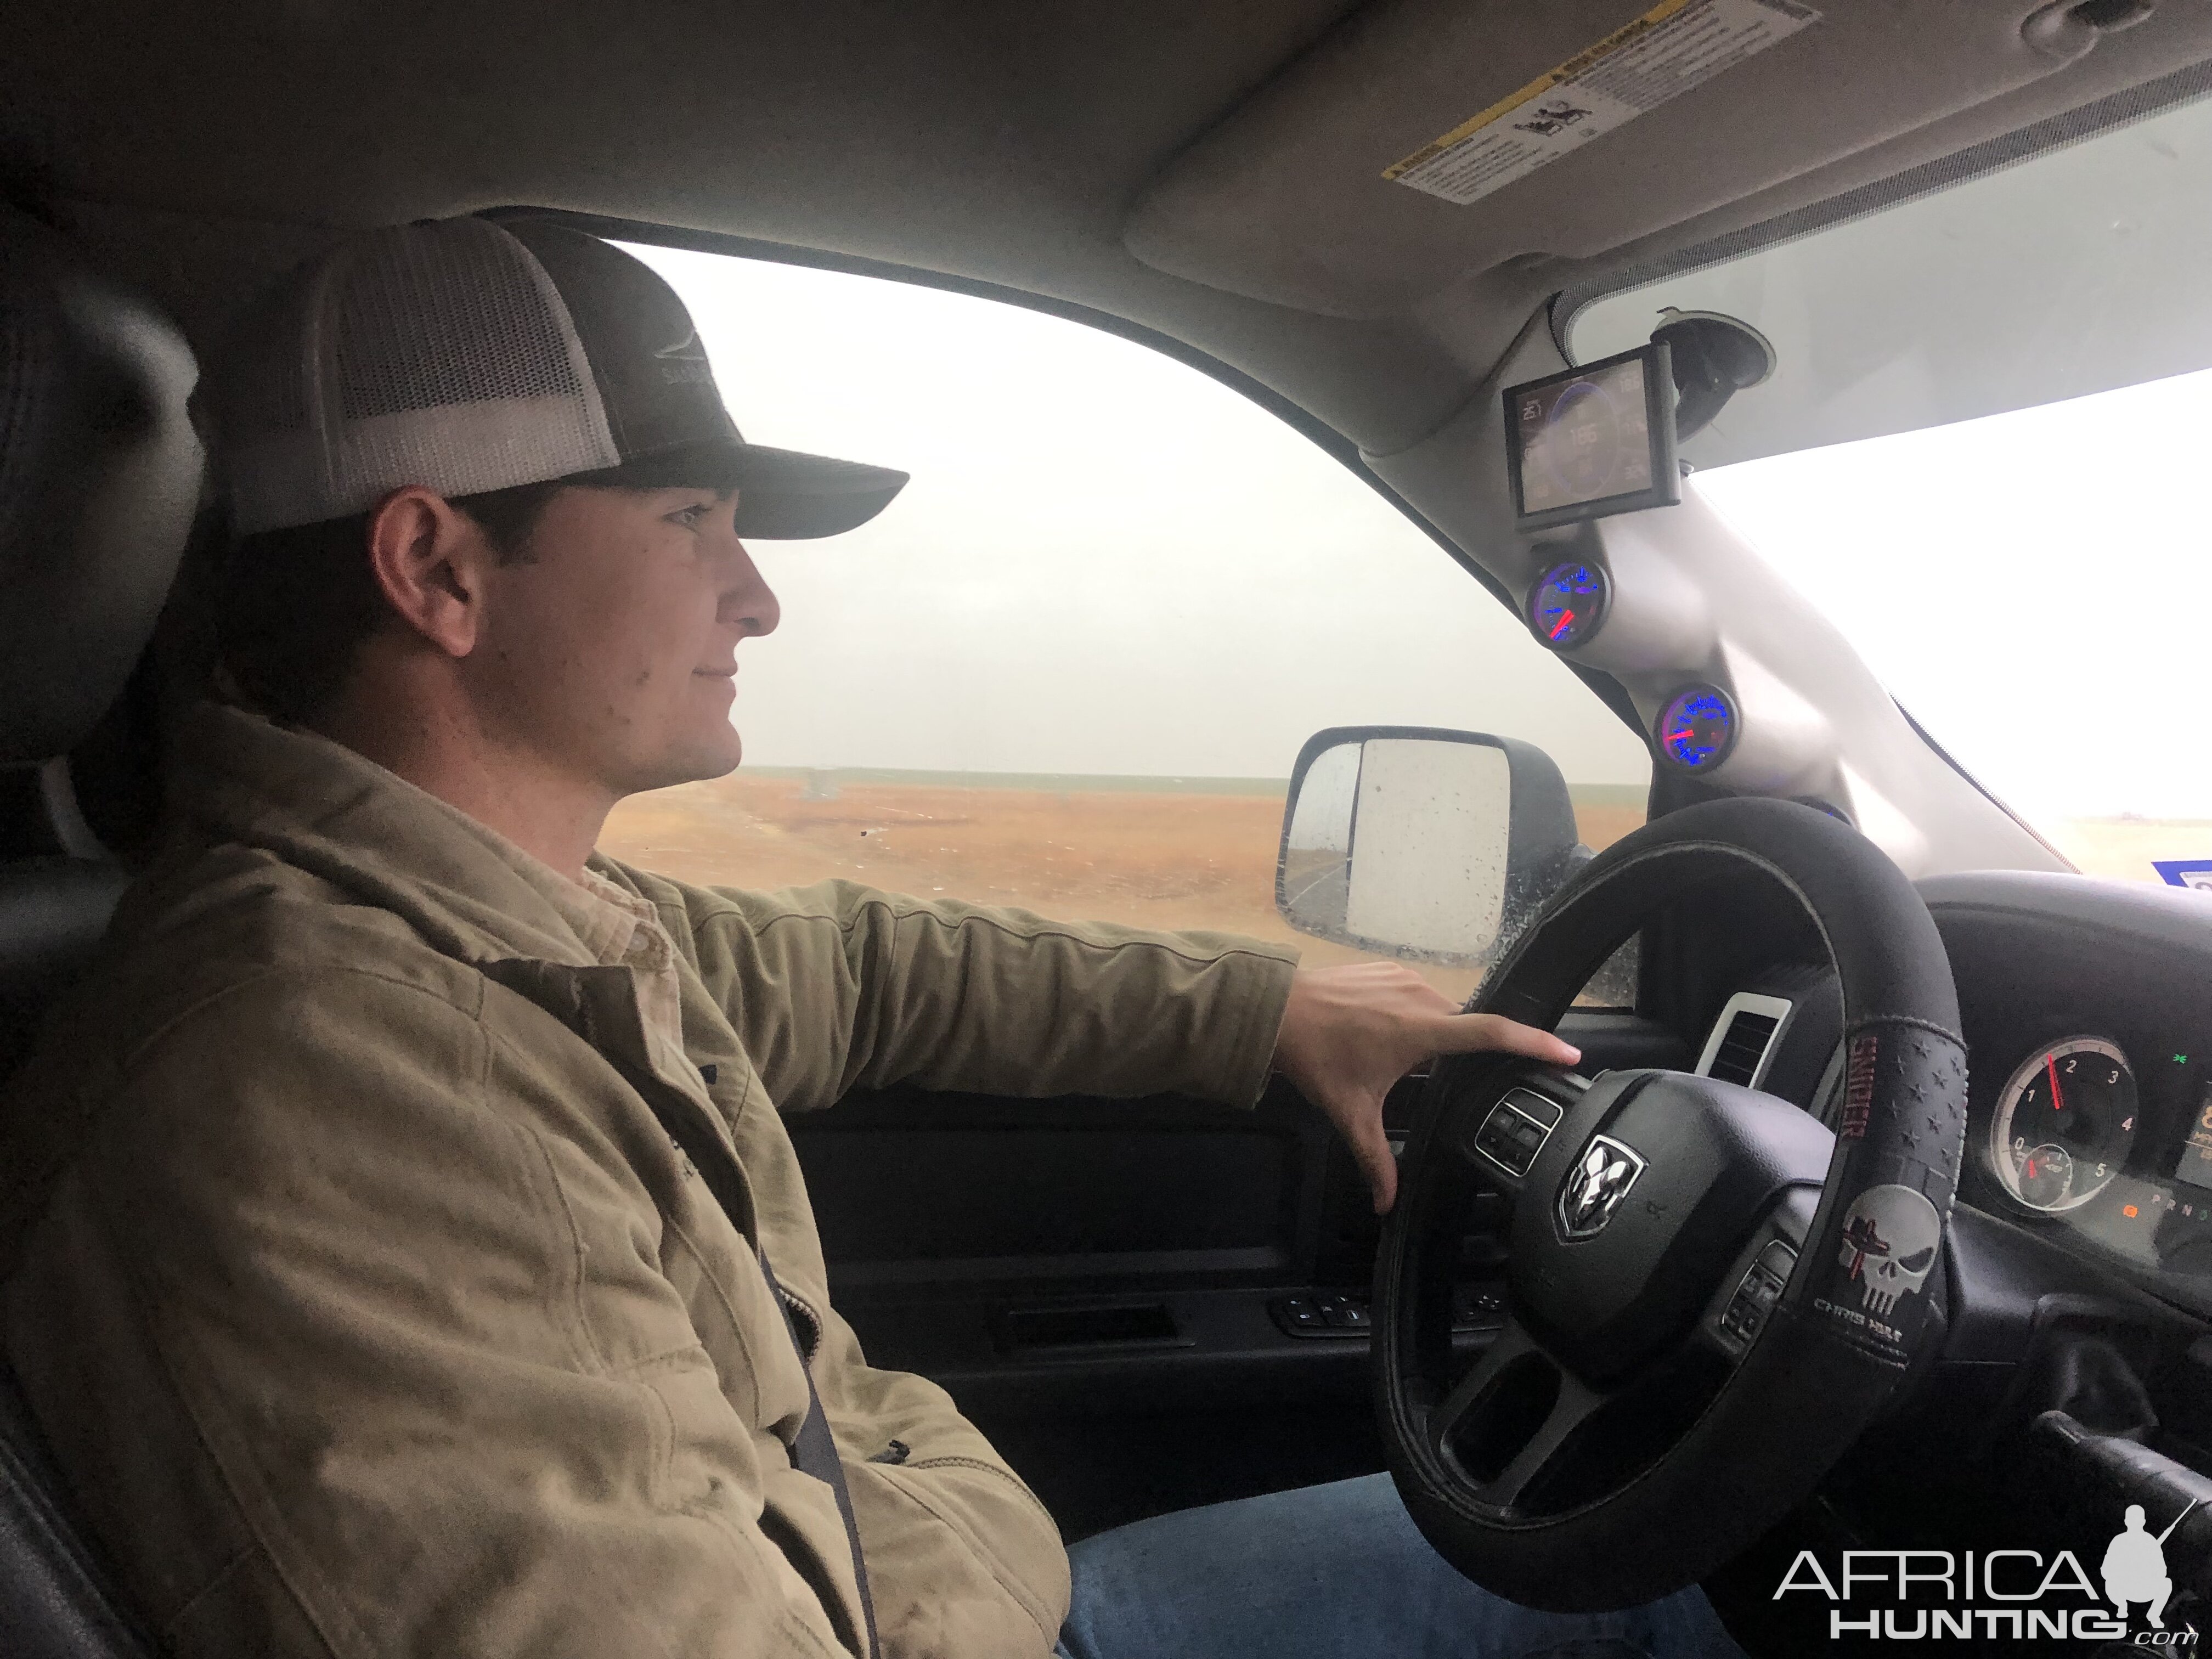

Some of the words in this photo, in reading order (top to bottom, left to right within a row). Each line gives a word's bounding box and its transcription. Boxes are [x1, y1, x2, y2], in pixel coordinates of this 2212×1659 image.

[2066, 1059, 2077, 1074] 2
[2109, 1070, 2119, 1084] 3
[2028, 1090, 2035, 1102] 1
[2121, 1118, 2133, 1131] 4
[2015, 1137, 2024, 1149] 0
[2095, 1163, 2107, 1177] 5
